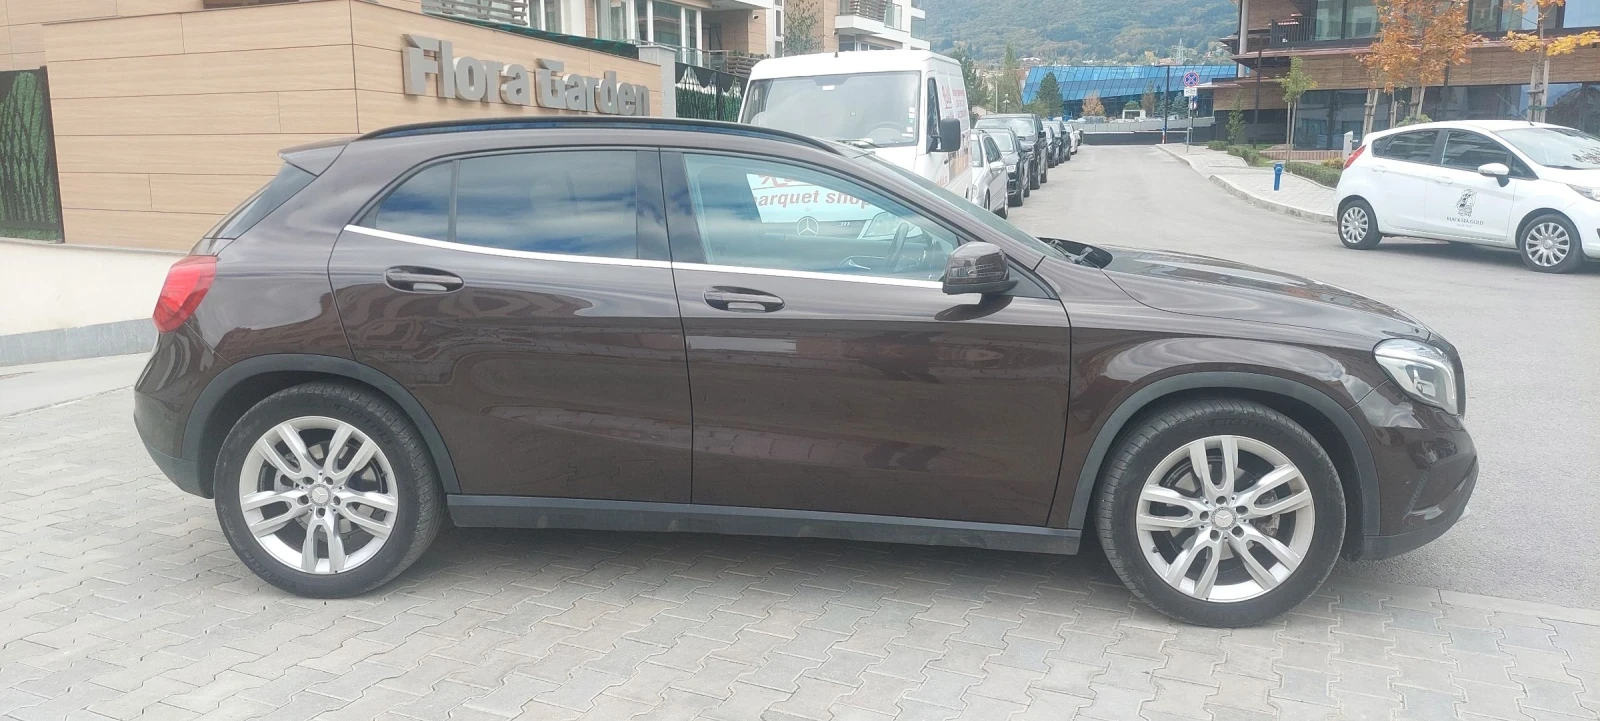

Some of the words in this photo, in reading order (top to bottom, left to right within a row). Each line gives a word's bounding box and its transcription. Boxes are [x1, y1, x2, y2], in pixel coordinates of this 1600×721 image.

[402, 34, 530, 106] Flora
[535, 58, 650, 116] Garden
[754, 190, 819, 207] arquet
